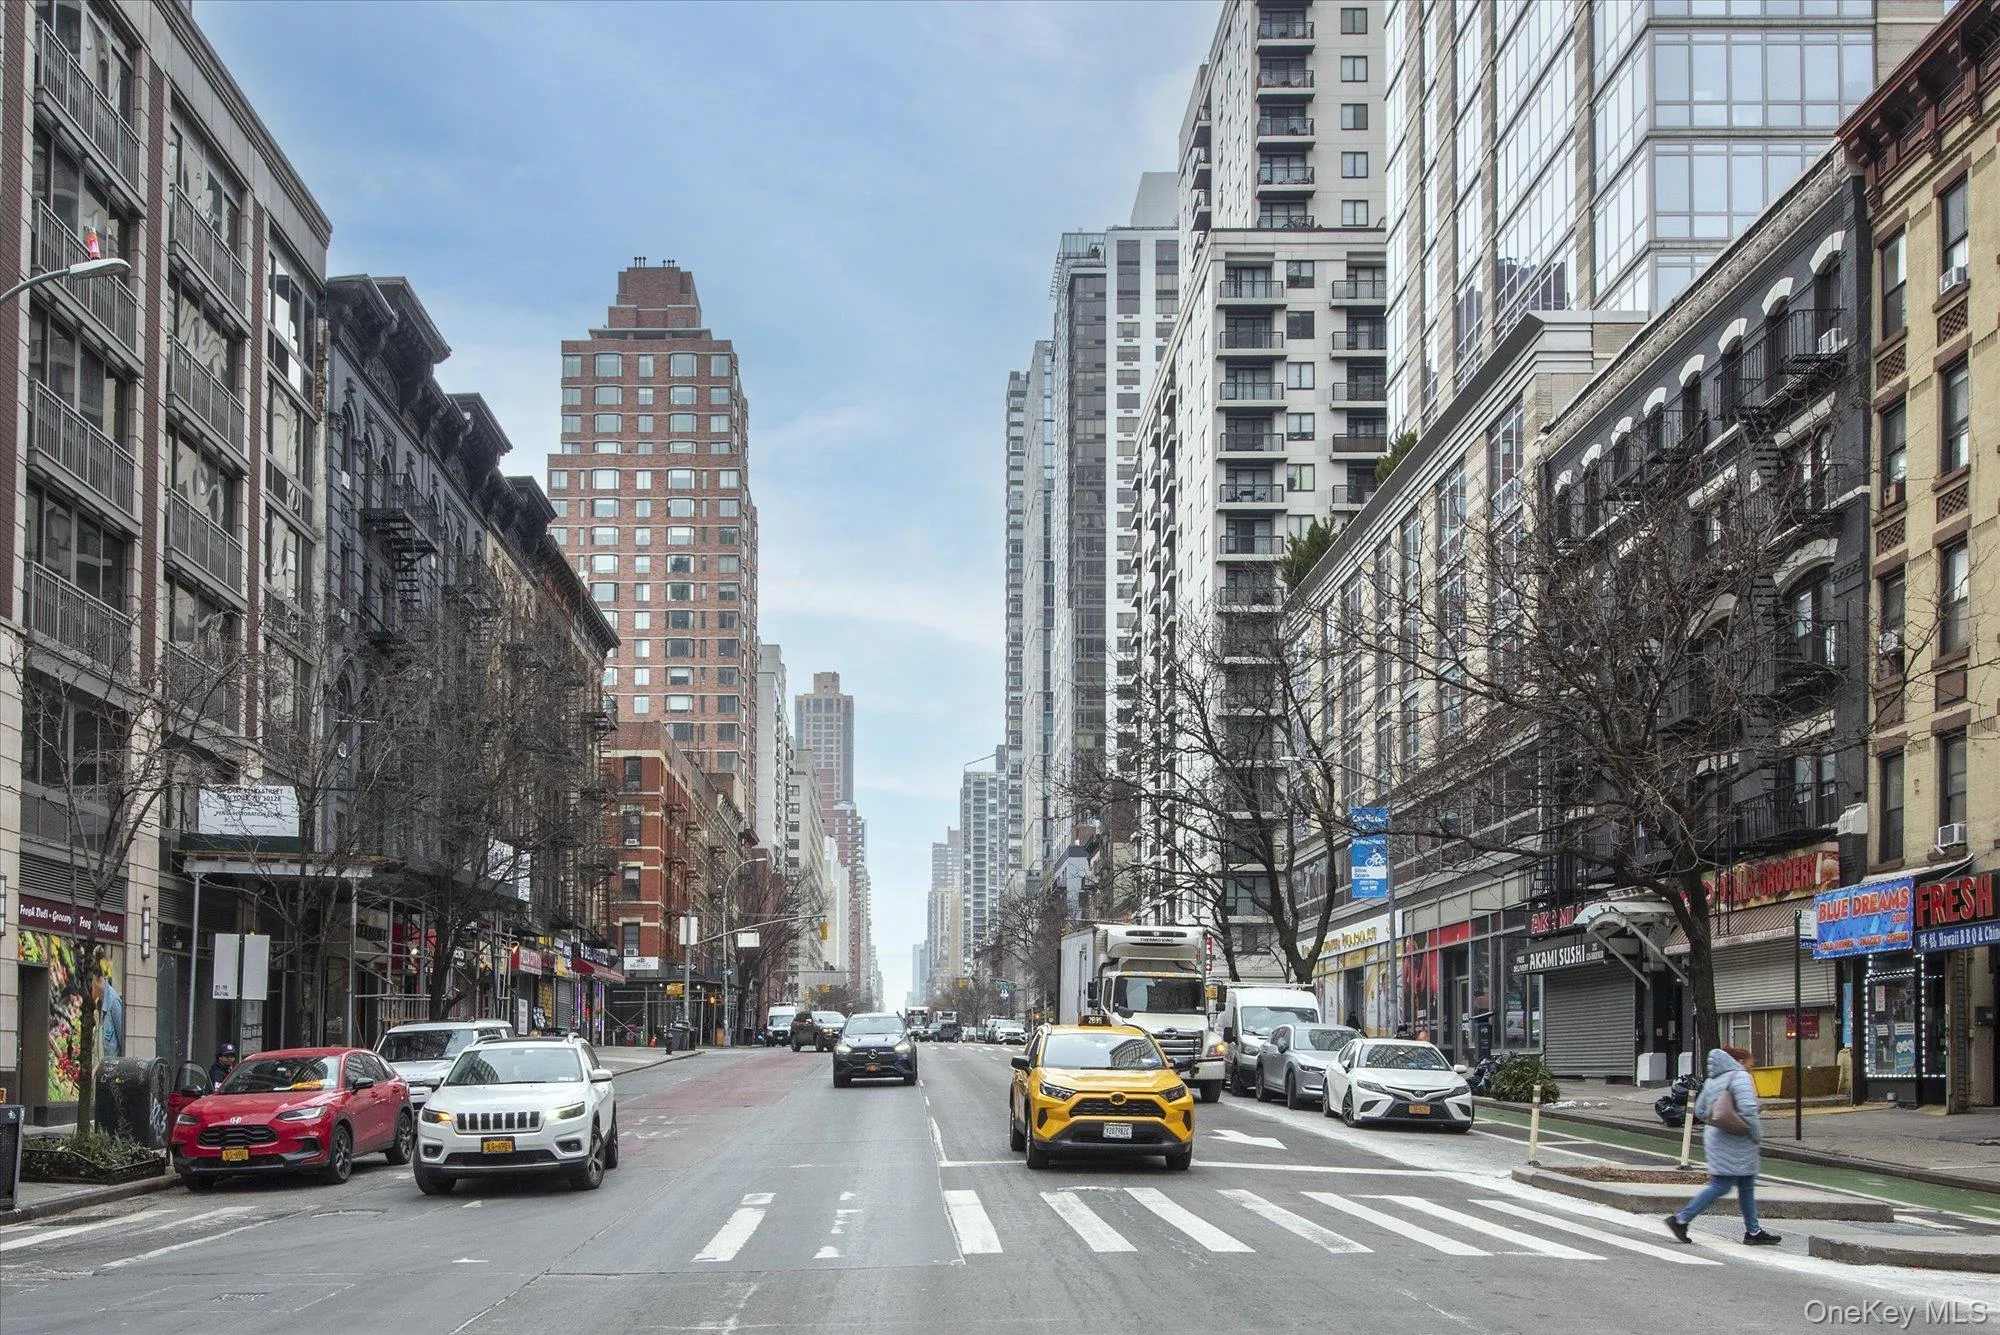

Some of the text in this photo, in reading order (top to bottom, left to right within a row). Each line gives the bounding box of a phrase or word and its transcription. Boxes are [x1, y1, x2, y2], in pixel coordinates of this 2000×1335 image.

[1759, 852, 1816, 898] GROCERY
[1818, 897, 1850, 923] BLUE
[1851, 886, 1910, 918] DREAMS
[1916, 873, 1993, 927] FRESH
[52, 911, 72, 925] Grocery
[1938, 930, 1959, 947] Hawaii
[1513, 964, 1529, 973] DELIVERY
[1529, 949, 1558, 970] AKAMI
[1559, 944, 1586, 966] SUSHI
